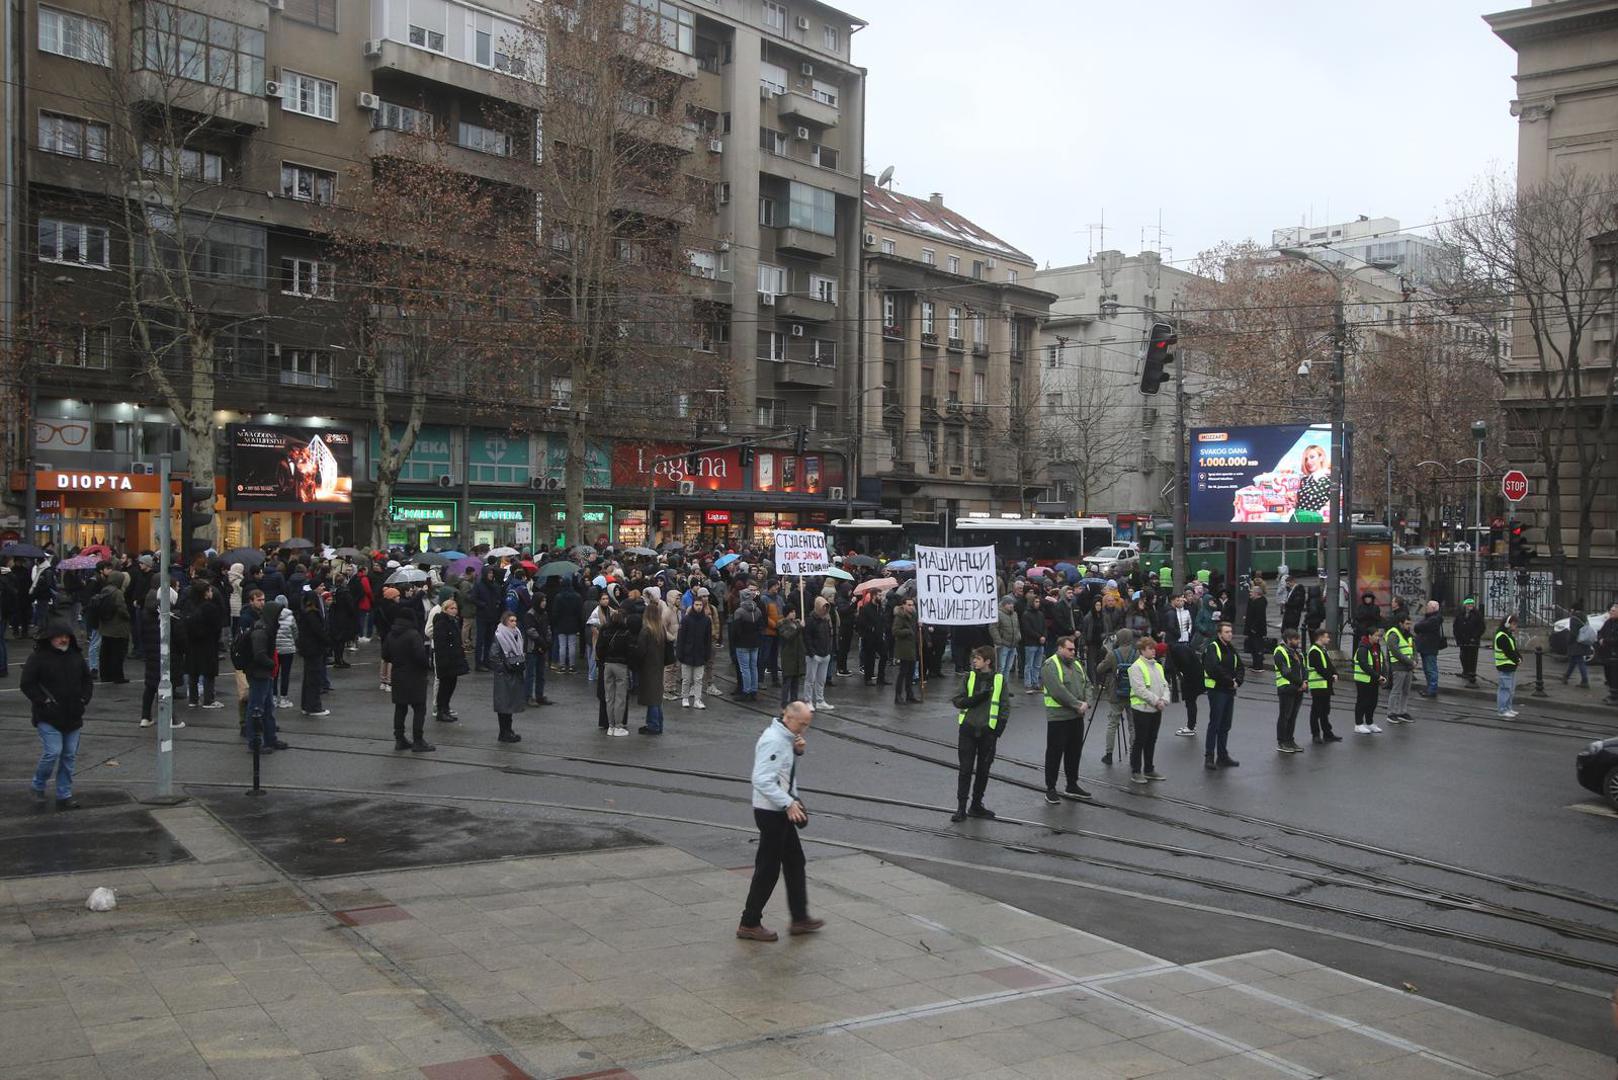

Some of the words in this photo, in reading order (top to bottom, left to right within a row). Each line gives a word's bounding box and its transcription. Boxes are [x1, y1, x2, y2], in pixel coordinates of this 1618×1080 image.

[1200, 447, 1227, 455] SVAKOG
[1228, 447, 1248, 455] DANA
[1199, 456, 1247, 467] 1.000.000
[57, 474, 132, 490] DIOPTA
[1506, 480, 1525, 491] STOP
[41, 500, 60, 508] DIOPTA
[478, 510, 523, 520] APOTEKA
[707, 513, 728, 521] Laguna
[917, 551, 990, 572] МАШИНЦИ
[781, 562, 792, 574] ОД
[927, 574, 995, 594] ПРОТИВ
[920, 598, 996, 620] МАШИНЕРИЈЕ
